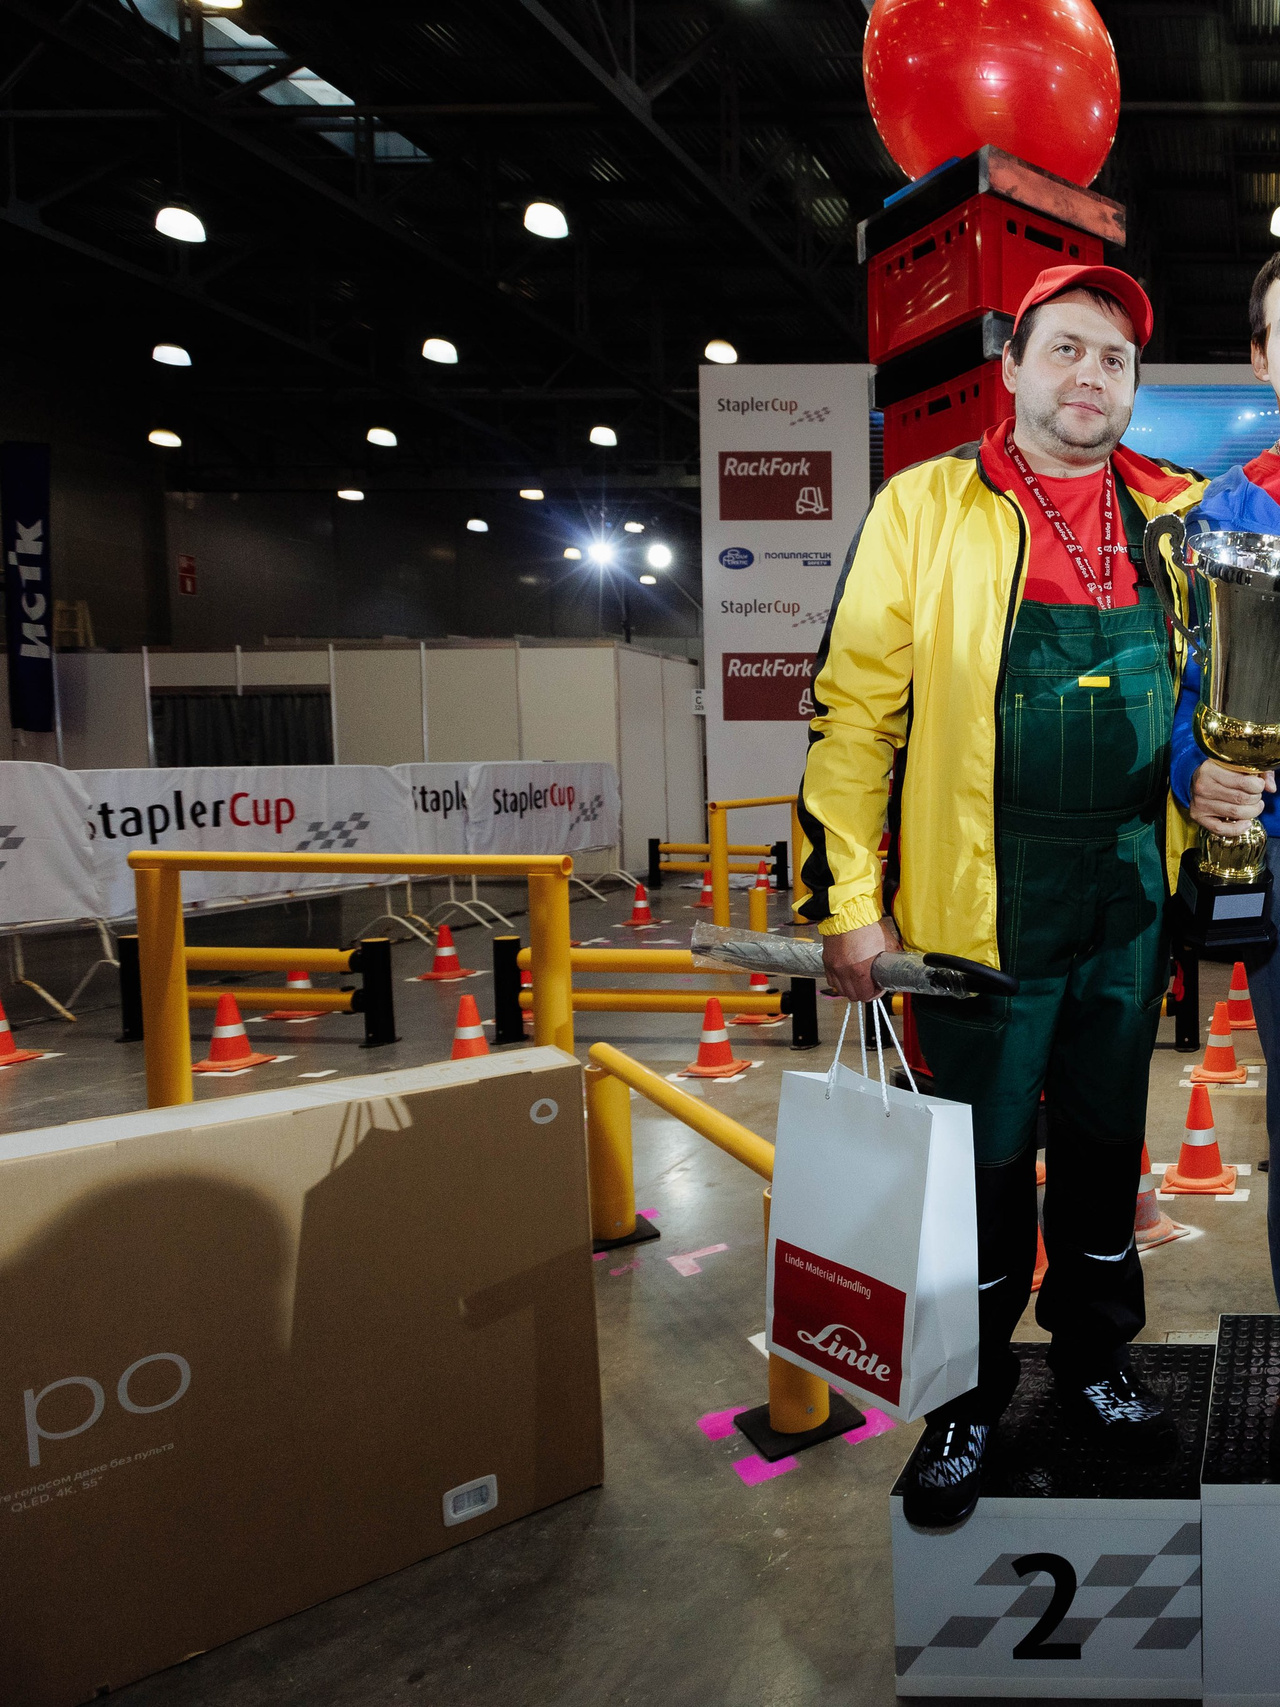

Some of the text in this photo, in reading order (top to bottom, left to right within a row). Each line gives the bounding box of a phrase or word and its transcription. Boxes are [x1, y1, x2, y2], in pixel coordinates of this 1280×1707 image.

[717, 397, 798, 415] StaplerCup
[724, 457, 810, 476] RackFork
[720, 599, 800, 617] StaplerCup
[727, 659, 813, 677] RackFork
[493, 782, 575, 819] StaplerCup
[784, 1252, 872, 1300] Linde Material Handling
[797, 1323, 891, 1382] Linde
[14, 1475, 72, 1499] голосом
[74, 1463, 108, 1482] даже
[110, 1456, 132, 1469] без
[134, 1442, 175, 1460] пульта
[1011, 1552, 1082, 1660] 2
